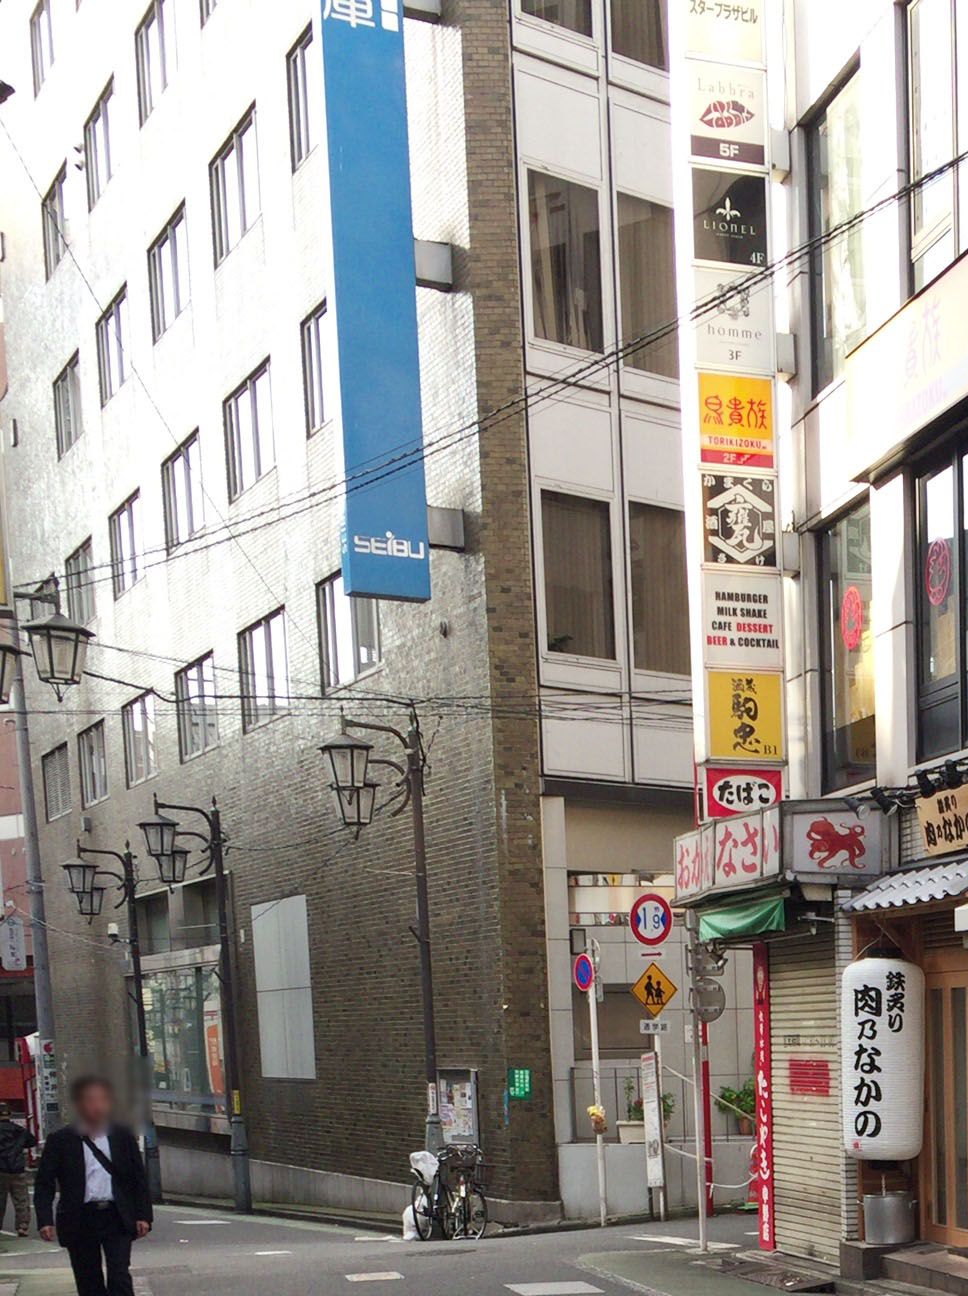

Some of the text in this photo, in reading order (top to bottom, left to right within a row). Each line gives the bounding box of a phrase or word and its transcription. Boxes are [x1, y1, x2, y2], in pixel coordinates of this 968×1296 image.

[719, 143, 739, 158] 5F
[750, 251, 765, 264] 4F
[707, 323, 762, 342] homme
[728, 349, 742, 361] 3F
[708, 435, 761, 449] TORIKIZOKU
[723, 452, 737, 464] 2F
[715, 591, 769, 605] HAMBURGER
[716, 606, 768, 619] MILK SHAKE
[711, 620, 774, 635] CAFE DESSERT
[706, 635, 780, 650] BEER & COCKTAIL
[718, 781, 773, 804] たばこ
[853, 984, 883, 1138] 肉乃なかの
